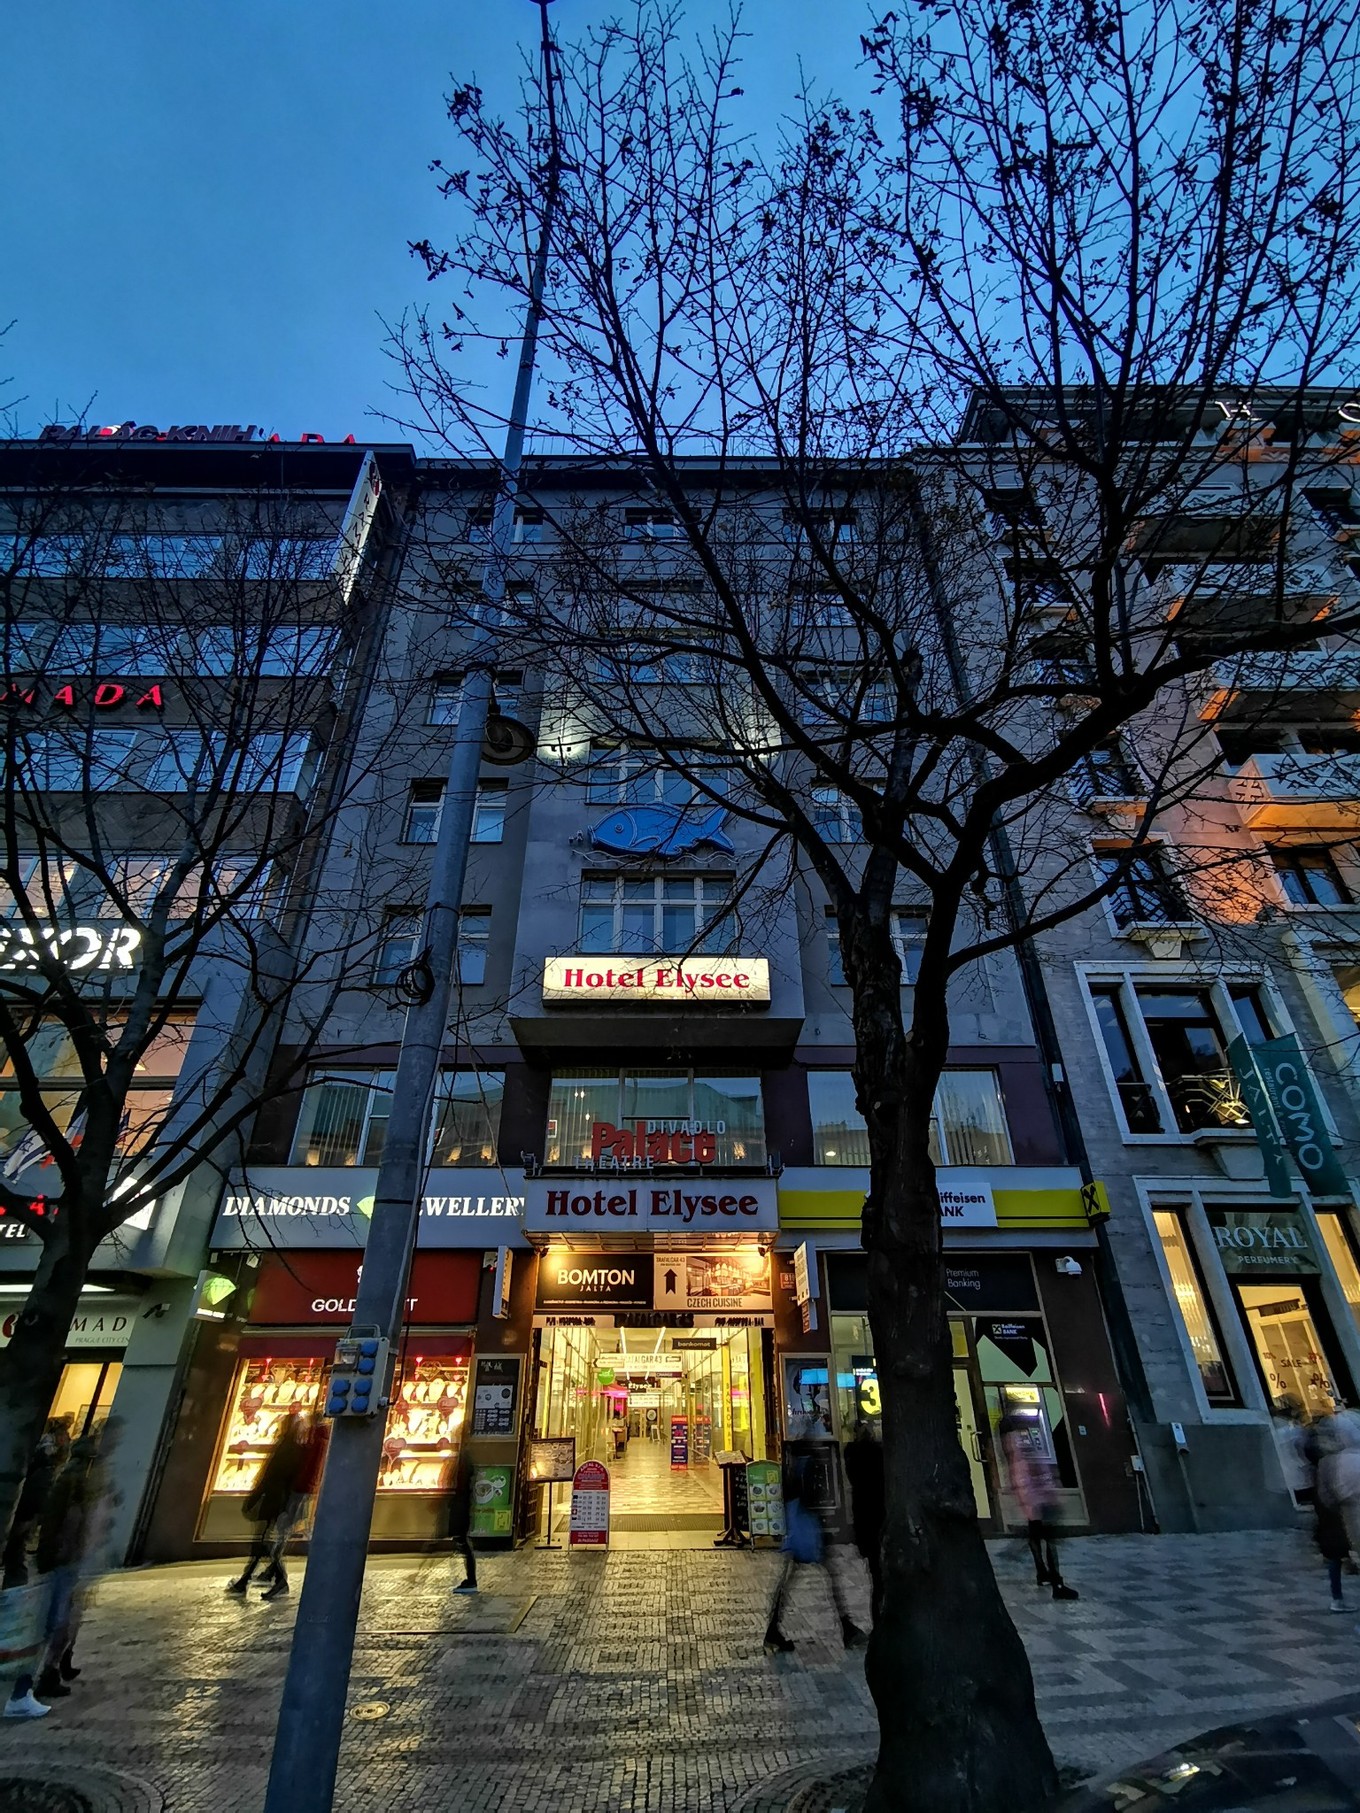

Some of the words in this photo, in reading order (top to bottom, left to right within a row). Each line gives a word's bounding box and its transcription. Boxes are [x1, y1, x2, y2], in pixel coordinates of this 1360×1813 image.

[164, 424, 258, 442] KNIH
[564, 968, 643, 988] Hotel
[656, 968, 750, 993] Elysee
[1275, 1062, 1324, 1170] COMO
[647, 1120, 726, 1136] DIVADLO
[592, 1120, 716, 1164] Palace
[575, 1155, 655, 1171] THEATRE
[939, 1191, 986, 1204] iffeisen
[222, 1196, 351, 1217] DIAMONDS
[419, 1196, 524, 1217] WELLER
[545, 1190, 638, 1216] Hotel
[650, 1190, 759, 1222] Elysee
[1212, 1226, 1309, 1248] ROYAL
[1238, 1255, 1298, 1265] PERFUMERY
[557, 1269, 635, 1285] BOMTON
[945, 1268, 980, 1277] Premium
[947, 1278, 981, 1290] Banking
[687, 1297, 712, 1308] CZECH
[712, 1297, 743, 1308] CUISINE
[1281, 1359, 1303, 1368] SALE
